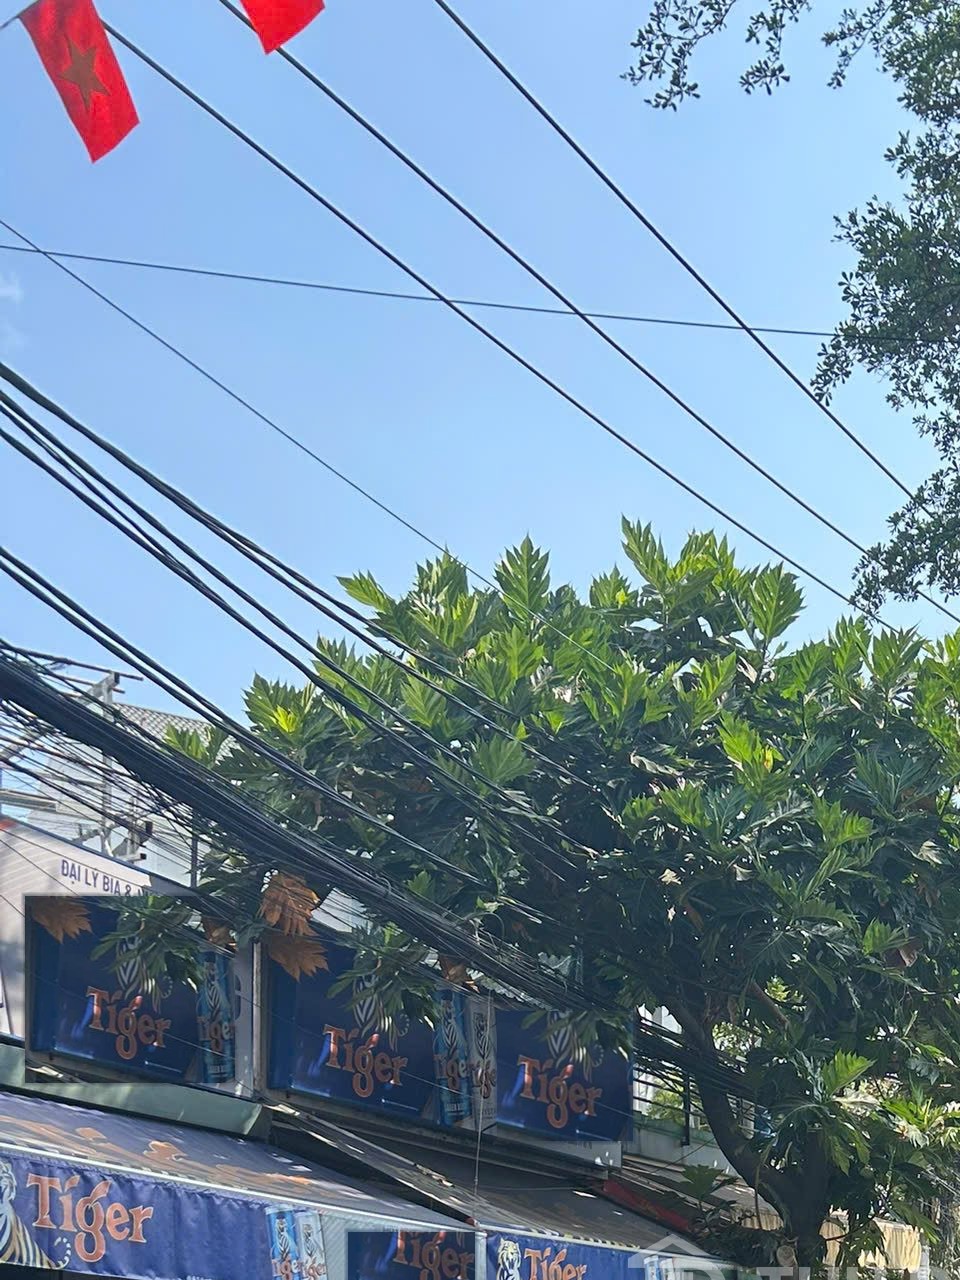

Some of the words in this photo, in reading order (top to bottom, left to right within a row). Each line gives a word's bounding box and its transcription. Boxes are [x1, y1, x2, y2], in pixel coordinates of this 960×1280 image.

[61, 859, 81, 885] ĐẠI
[102, 875, 121, 897] BIA
[86, 986, 171, 1060] Tiger
[323, 1024, 408, 1098] Tiger
[518, 1055, 602, 1129] Tiger
[27, 1173, 154, 1263] Tiger
